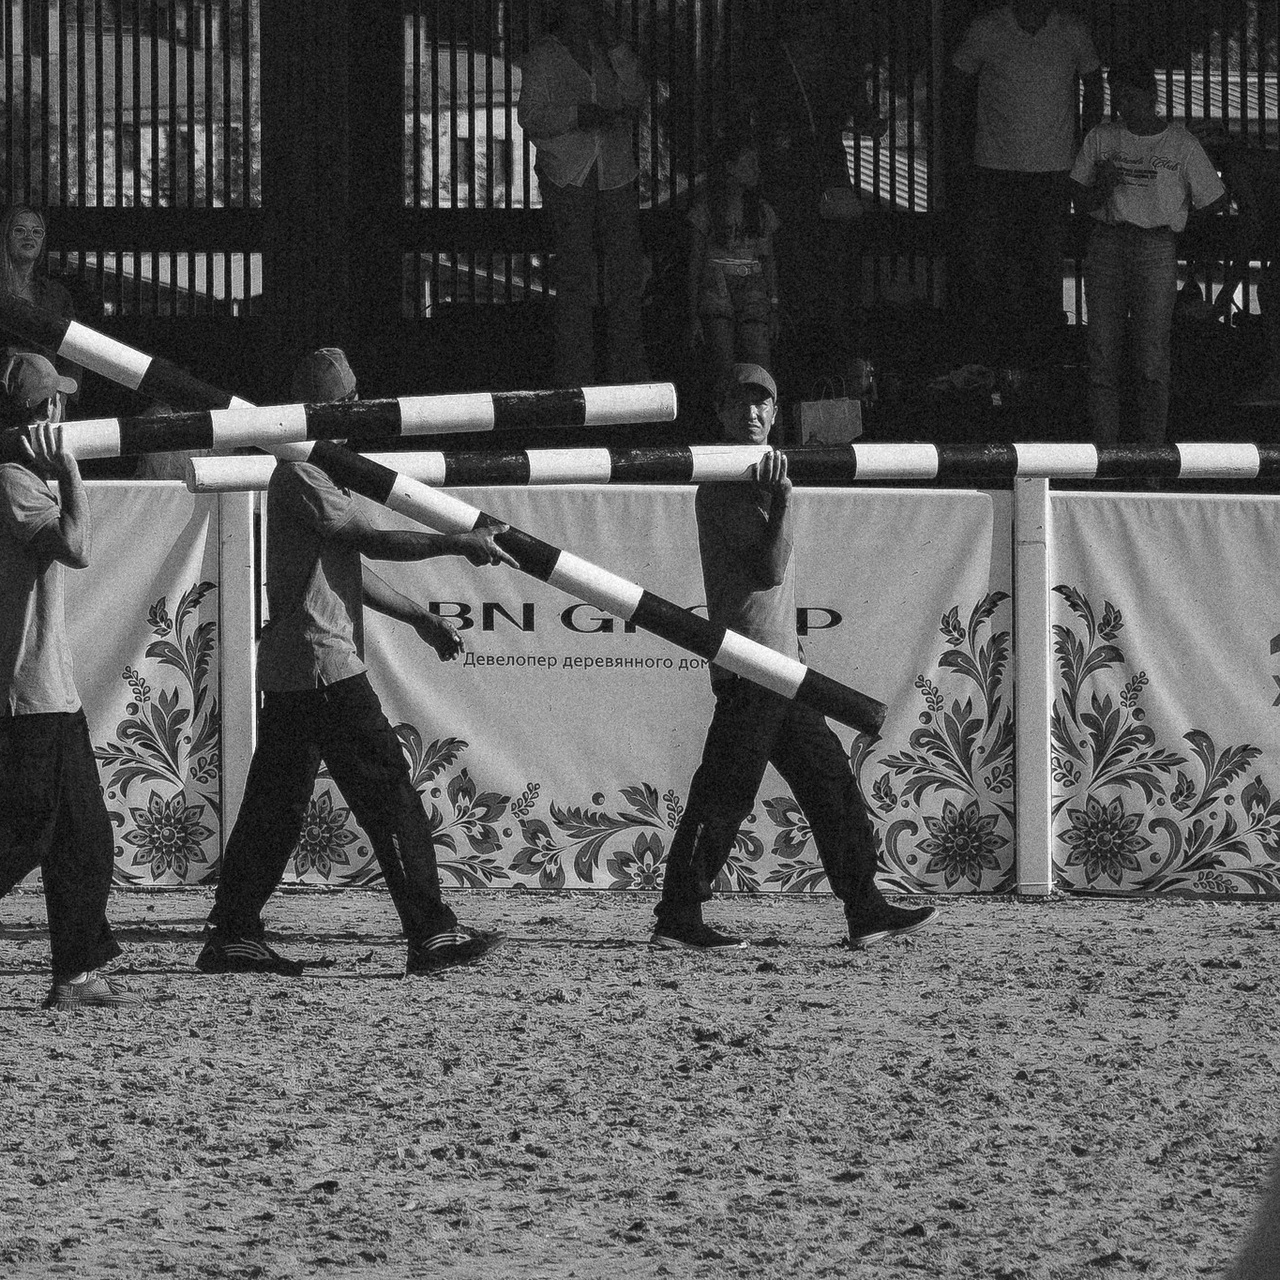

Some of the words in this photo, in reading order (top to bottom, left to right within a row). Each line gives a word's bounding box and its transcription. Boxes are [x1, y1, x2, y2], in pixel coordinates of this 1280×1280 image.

[428, 601, 535, 632] BN
[463, 652, 558, 669] Девелопер
[562, 656, 673, 670] деревянного
[678, 658, 711, 671] дом
